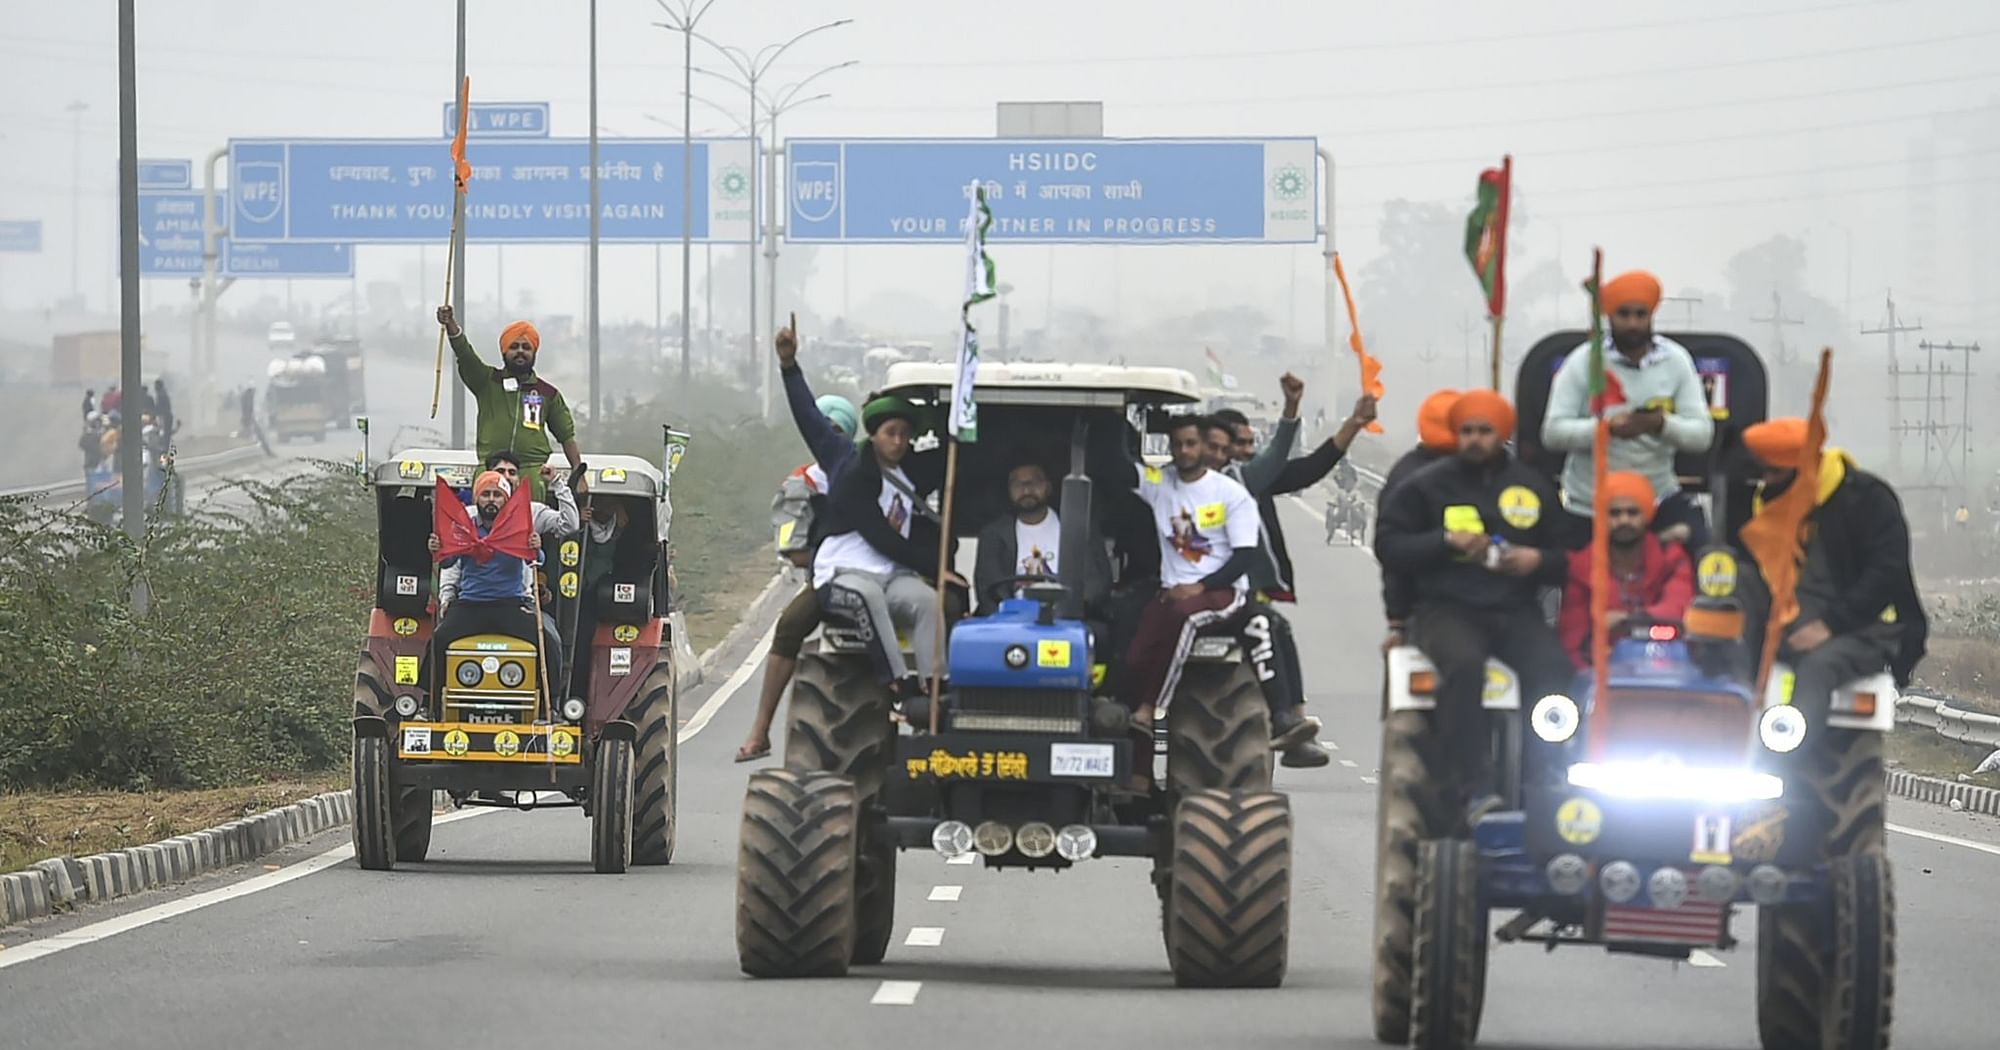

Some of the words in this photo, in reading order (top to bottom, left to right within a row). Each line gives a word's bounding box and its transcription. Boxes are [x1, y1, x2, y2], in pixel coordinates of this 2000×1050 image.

[489, 112, 535, 128] WPE
[512, 165, 569, 182] आगमन
[652, 161, 664, 183] है
[1008, 152, 1097, 172] HSIIDC
[243, 181, 278, 202] WPE
[797, 180, 834, 201] WPE
[1014, 179, 1027, 200] में
[1039, 183, 1092, 201] आपका
[1103, 179, 1143, 201] साथी
[329, 203, 397, 219] THANK
[541, 203, 592, 219] VISIT
[602, 203, 665, 219] AGAIN
[890, 217, 946, 233] YOUR
[1067, 217, 1091, 233] IN
[1103, 217, 1218, 234] PROGRESS
